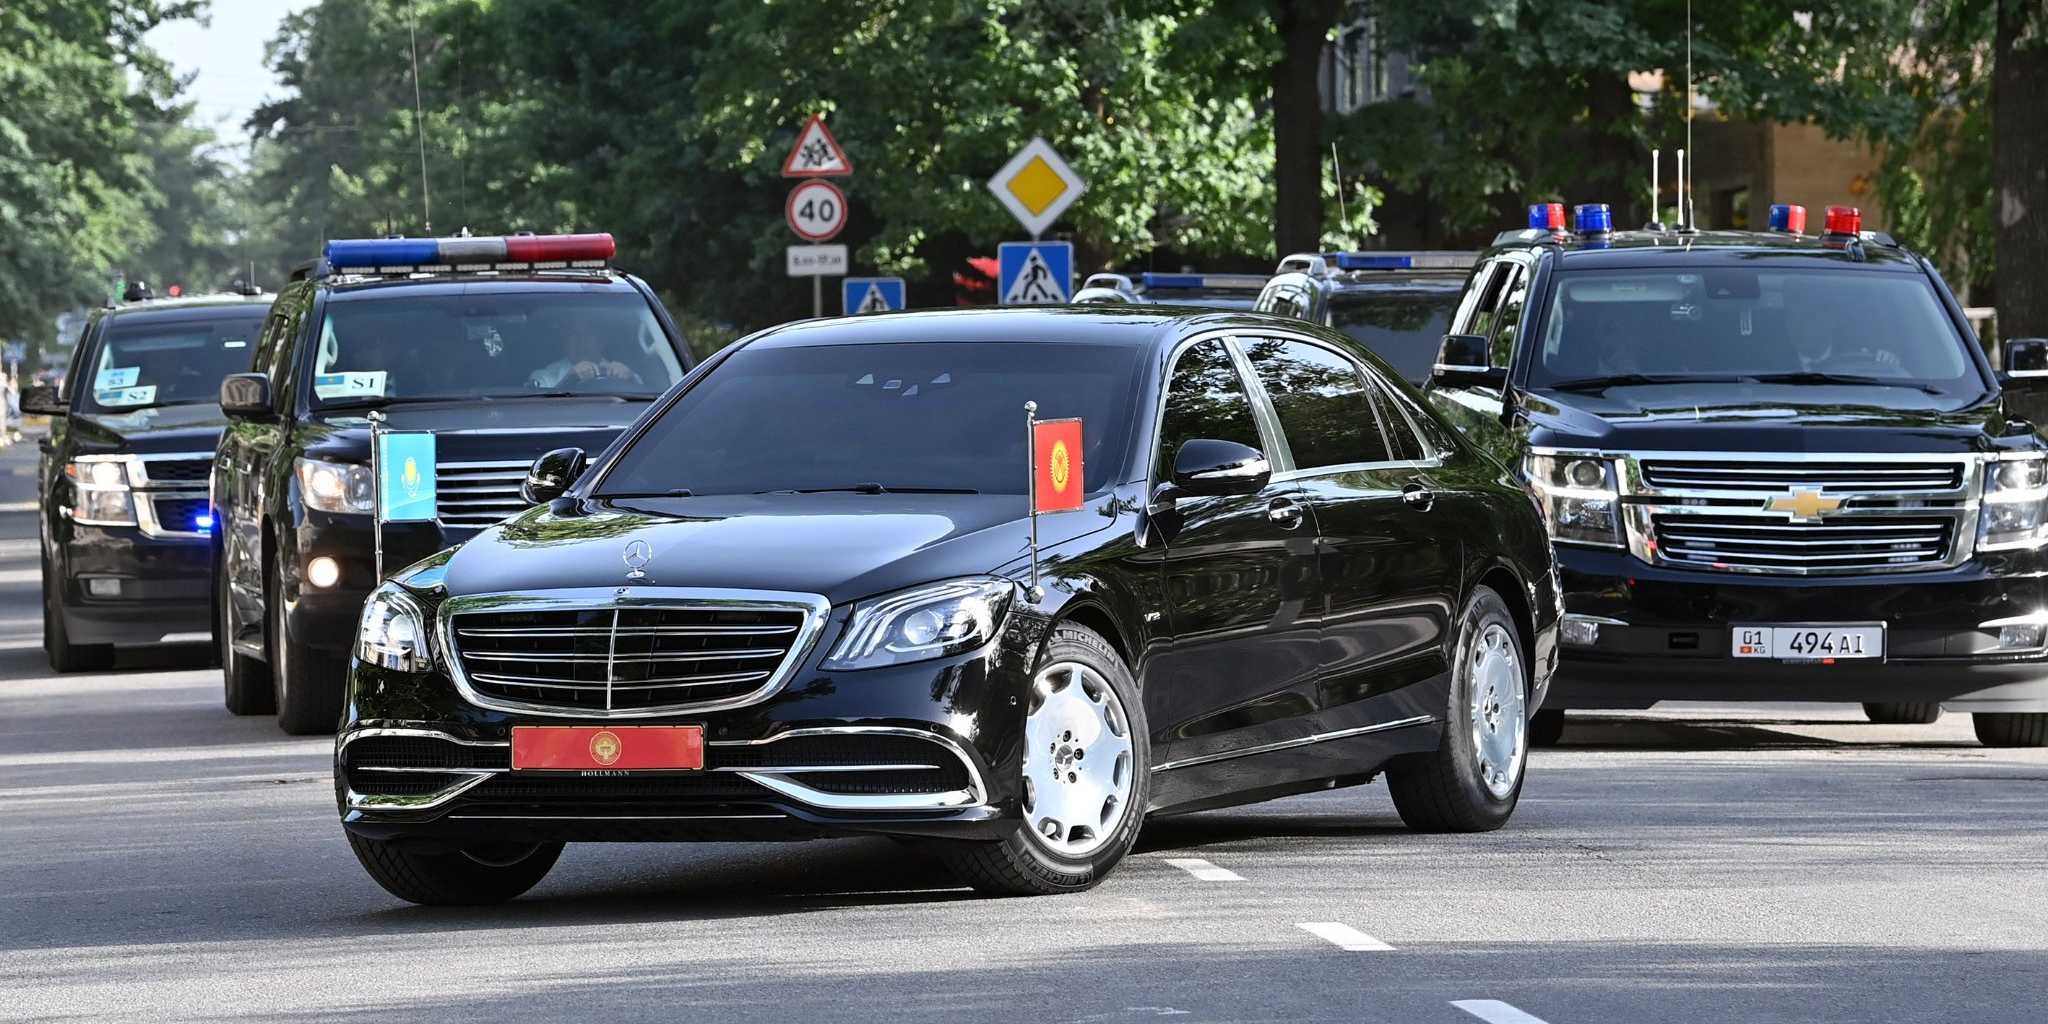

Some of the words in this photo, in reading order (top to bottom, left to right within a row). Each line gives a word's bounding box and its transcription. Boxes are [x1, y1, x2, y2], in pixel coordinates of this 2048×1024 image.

[799, 200, 834, 222] 40
[351, 377, 374, 389] S1
[1062, 629, 1116, 663] MICHELIN
[1743, 631, 1763, 645] 01
